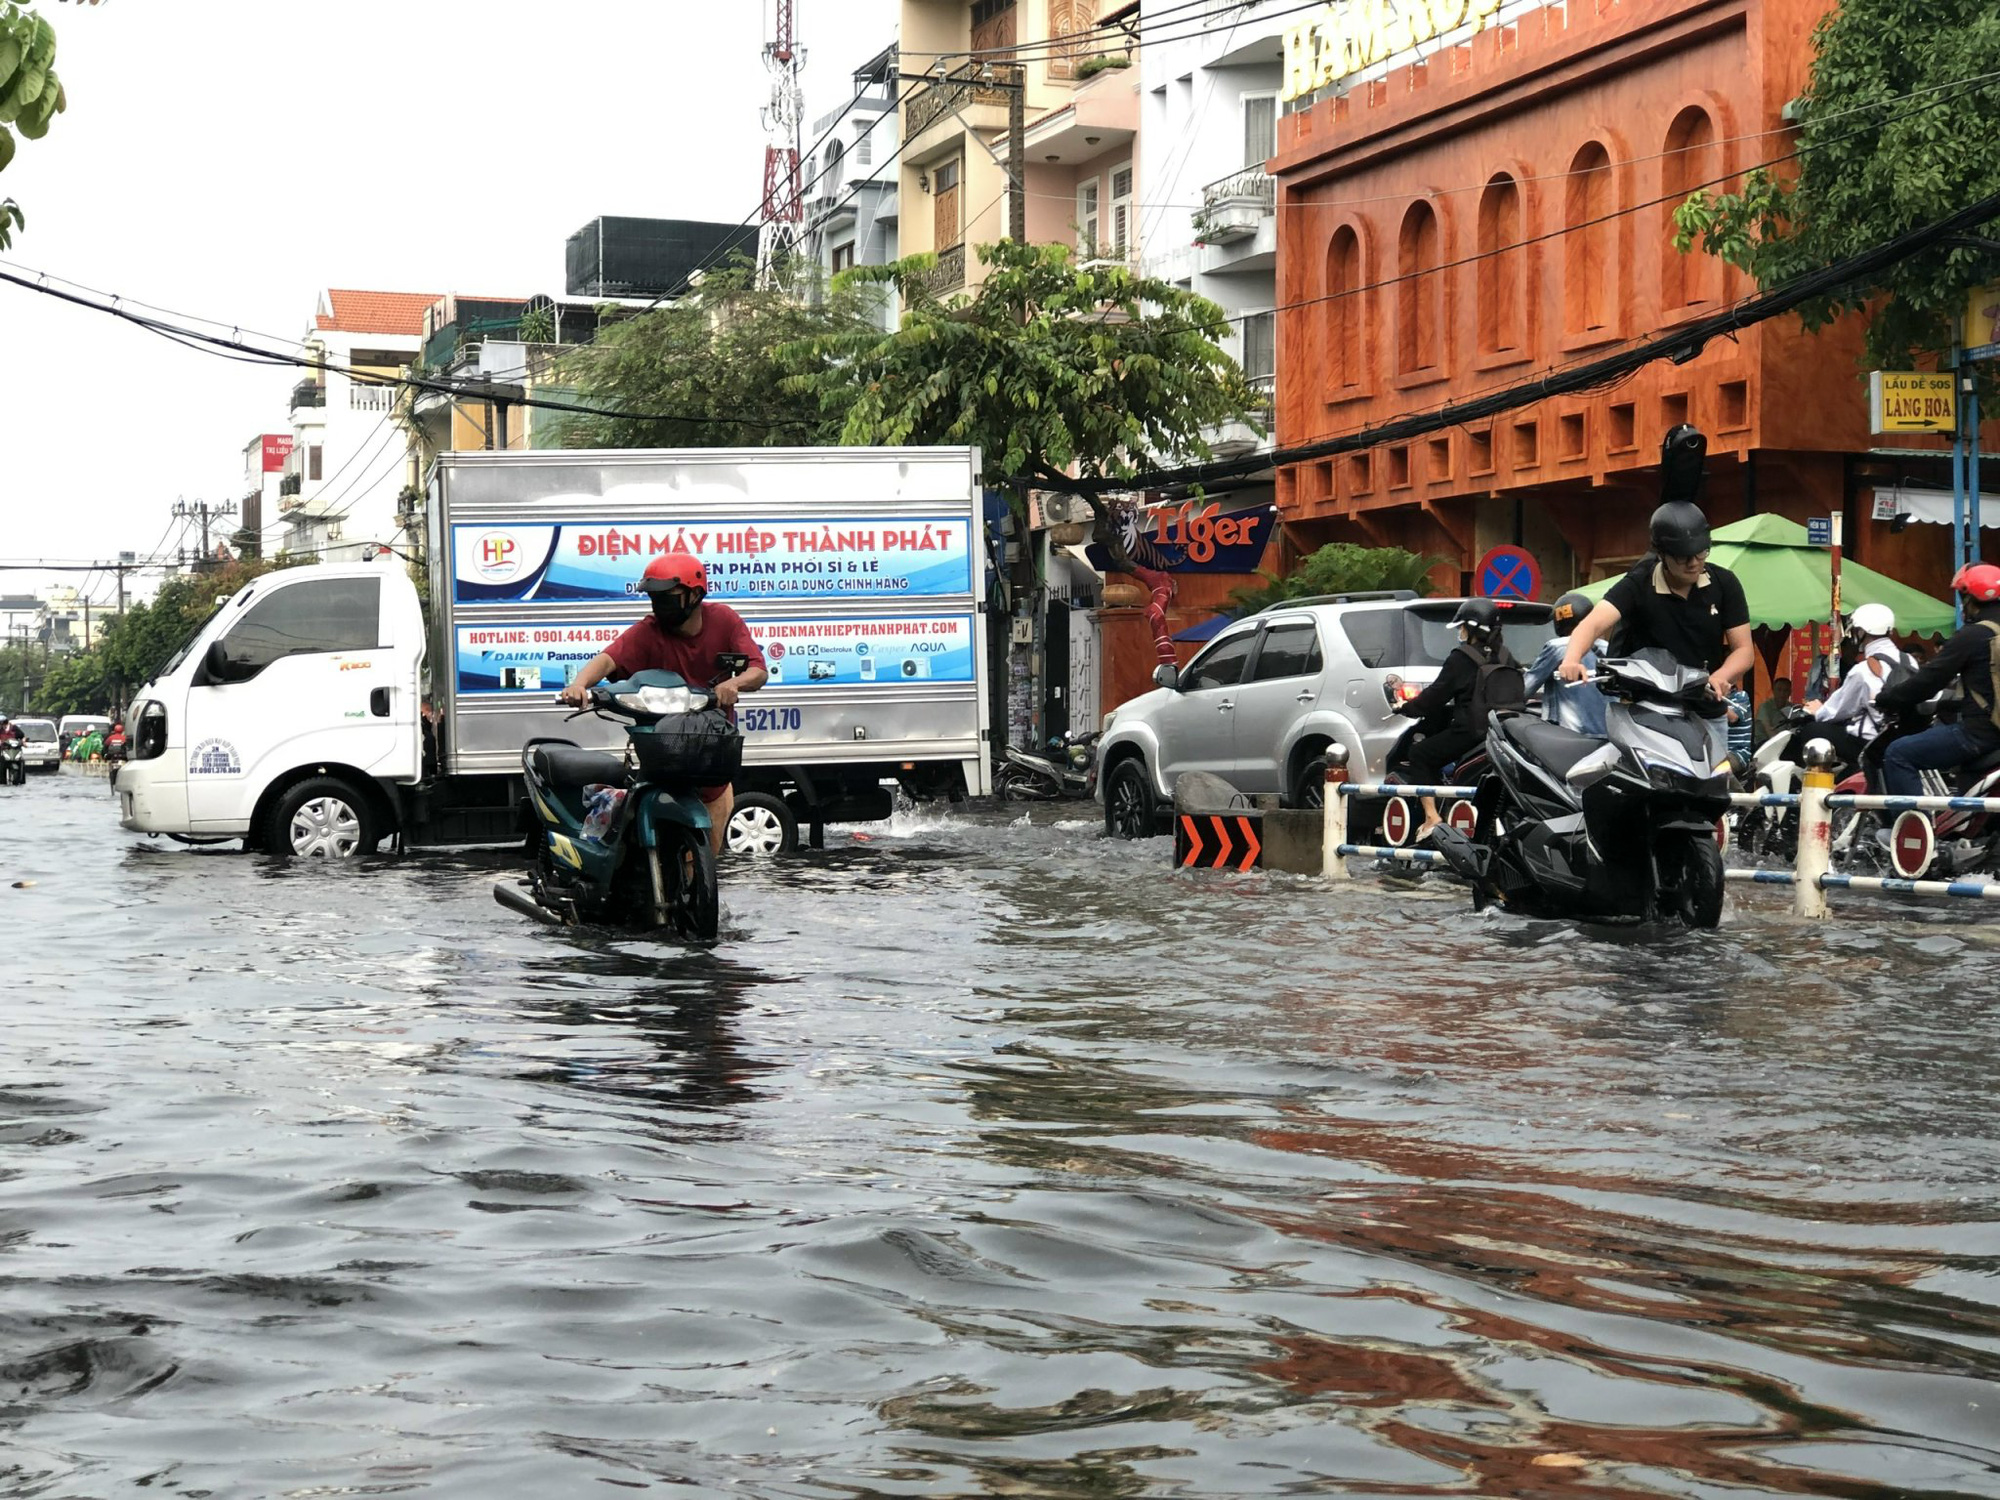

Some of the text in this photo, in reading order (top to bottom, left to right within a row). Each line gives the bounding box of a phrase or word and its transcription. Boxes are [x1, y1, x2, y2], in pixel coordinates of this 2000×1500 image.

[1930, 380, 1951, 389] SOS
[1885, 392, 1951, 417] LÀNG HOA
[1147, 500, 1260, 563] Tiger
[578, 524, 952, 562] ĐIỆN MÁY HIỆP THÀNH PHÁT
[729, 559, 776, 574] PHÂN
[781, 556, 822, 573] PHỐI
[847, 561, 858, 573] &
[778, 579, 799, 591] GIA
[469, 629, 619, 644] HOTLINE: 0901.444.862
[494, 651, 545, 662] DAIKIN
[789, 645, 806, 656] LG
[820, 646, 853, 654] Electrolux
